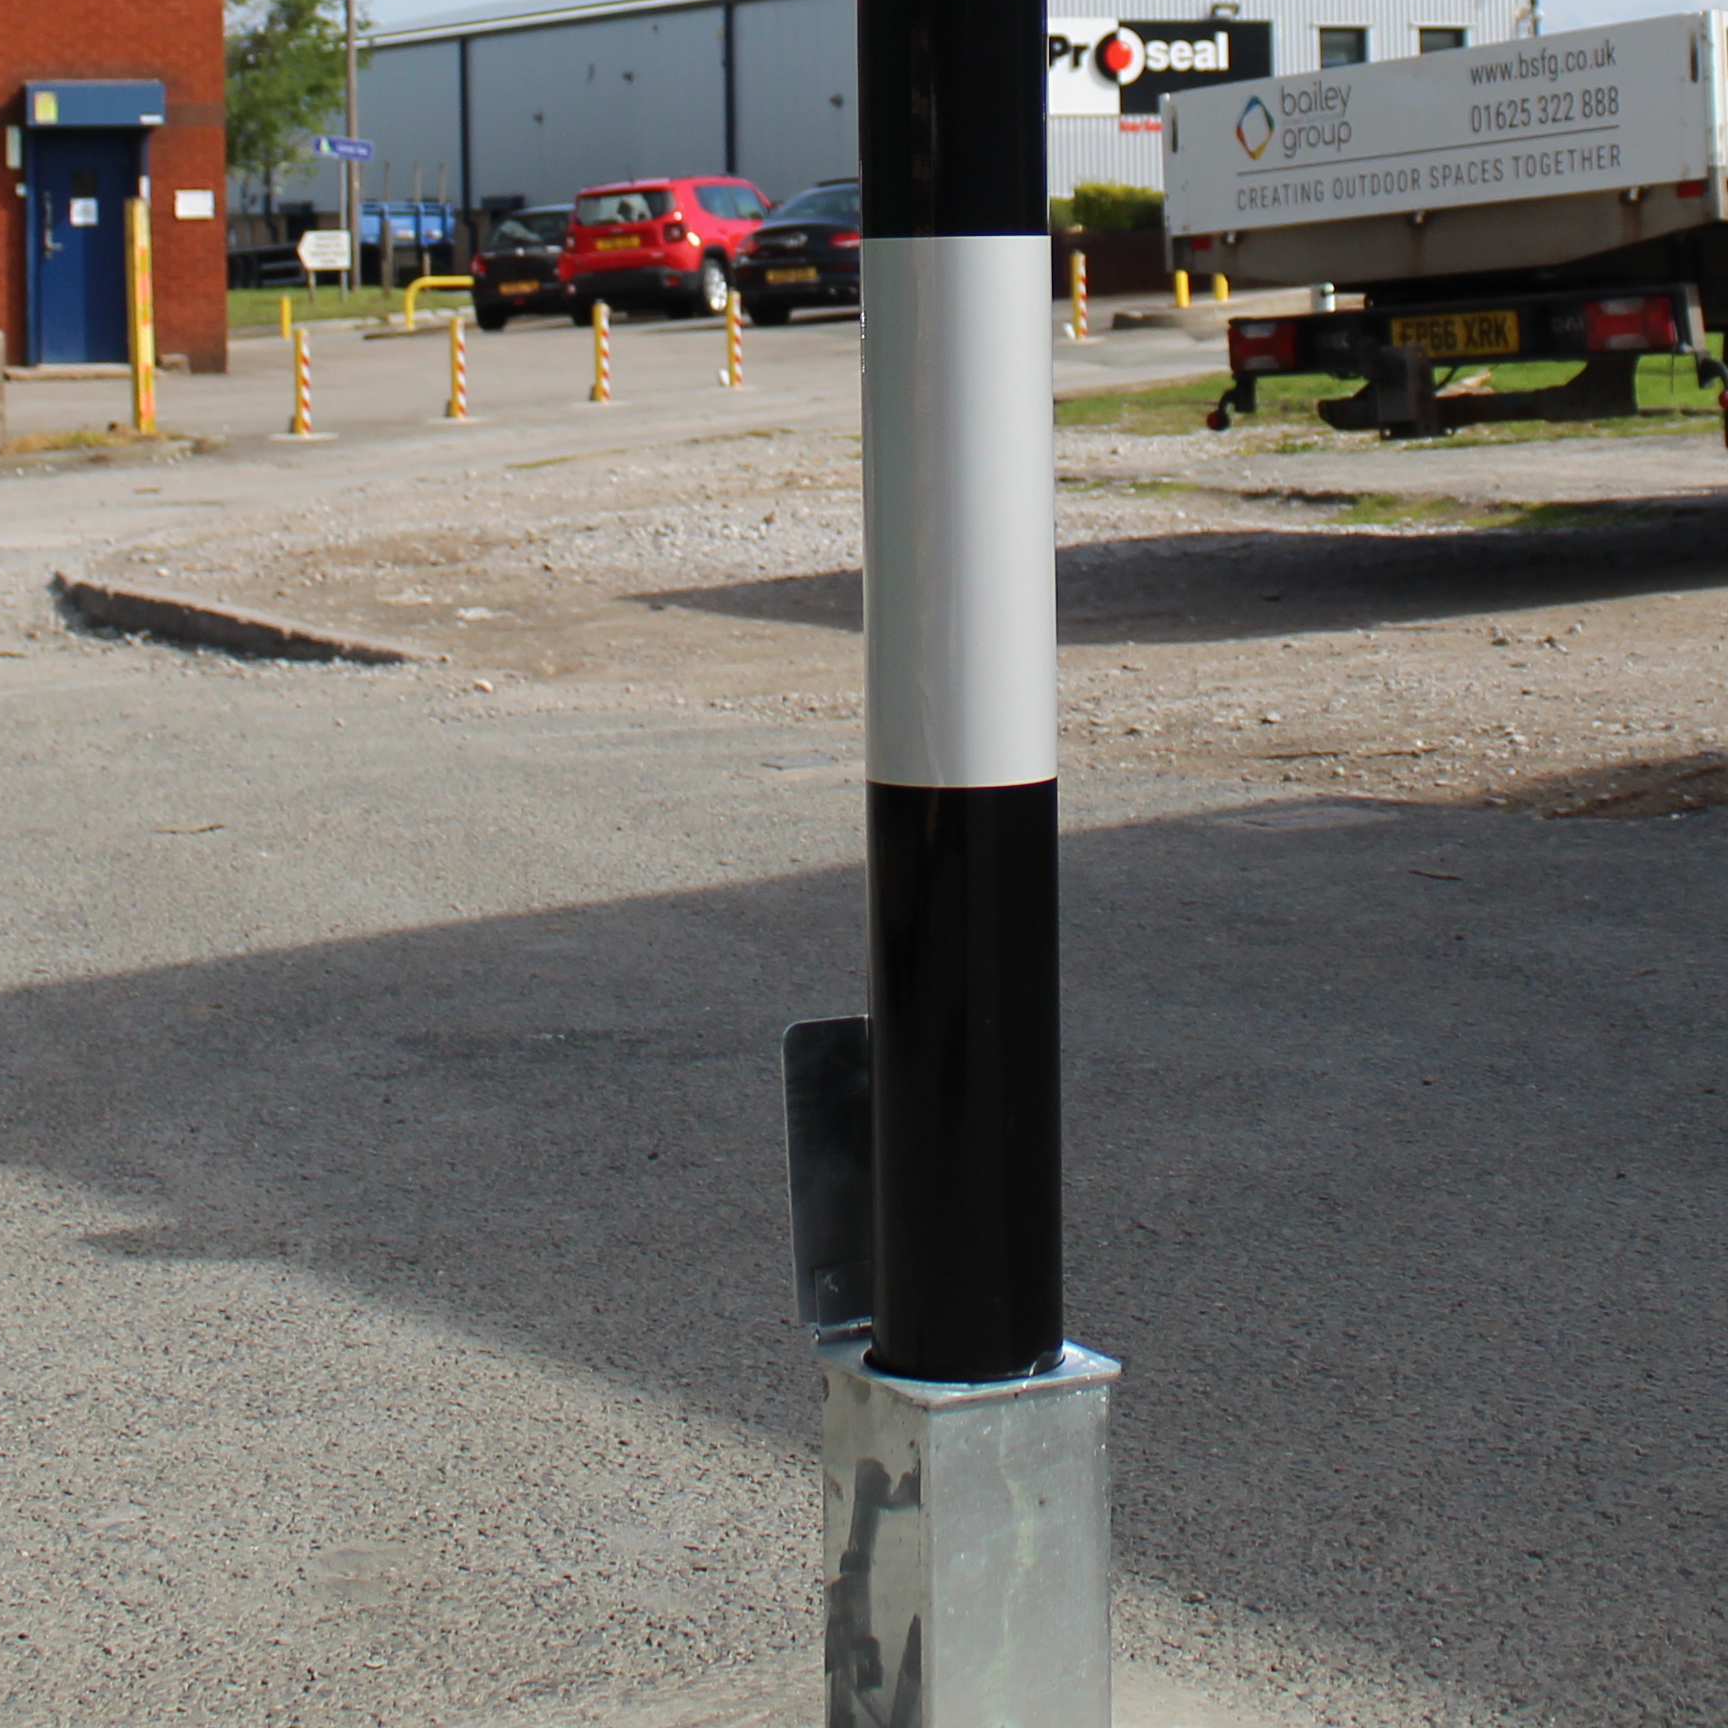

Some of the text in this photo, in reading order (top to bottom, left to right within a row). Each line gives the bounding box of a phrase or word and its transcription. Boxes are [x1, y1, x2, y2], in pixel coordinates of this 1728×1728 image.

[1471, 38, 1618, 86] www.bsfg.co.uk
[1281, 79, 1352, 117] bailey
[1471, 86, 1619, 134] 01625 322 888
[1283, 121, 1352, 159] group
[1237, 144, 1621, 210] CREATING OUTDOOR SPACES TOGETHER
[1462, 315, 1510, 350] XRK
